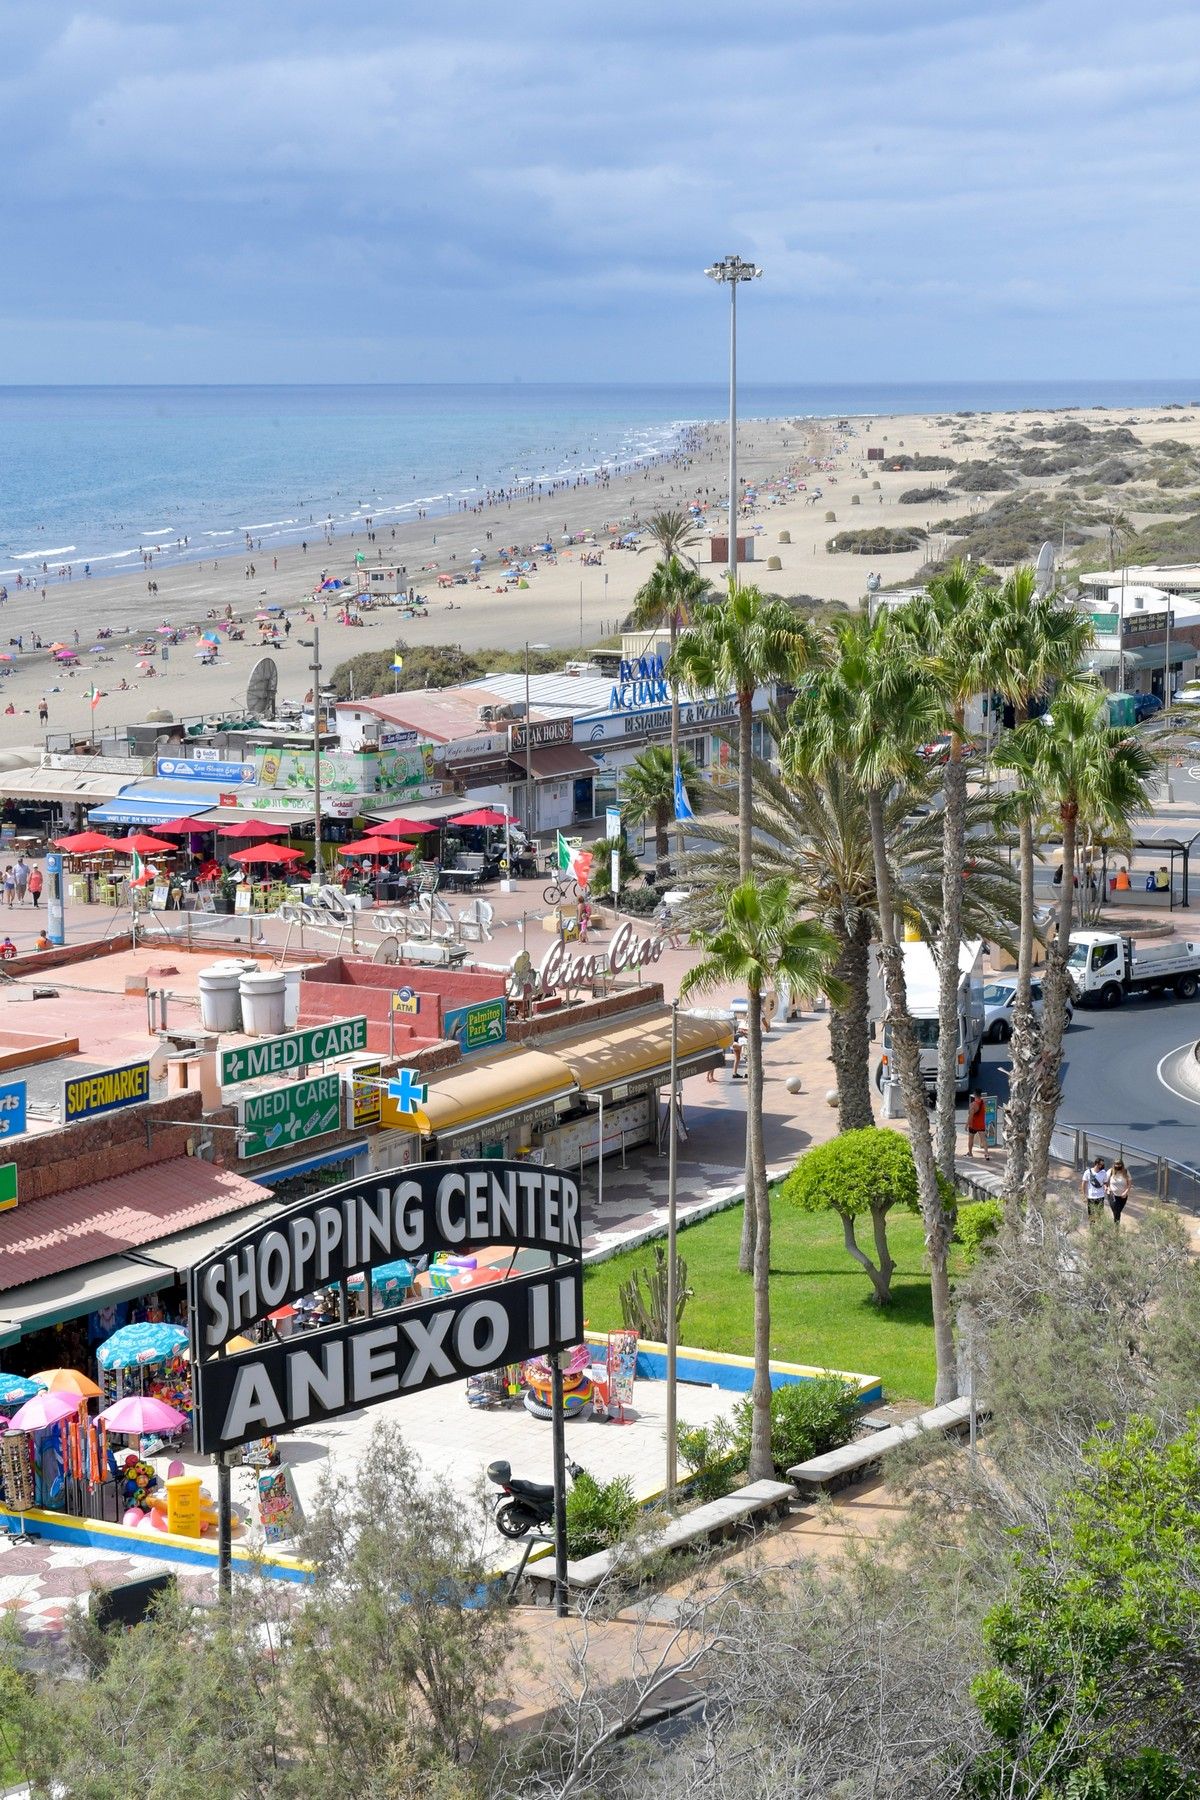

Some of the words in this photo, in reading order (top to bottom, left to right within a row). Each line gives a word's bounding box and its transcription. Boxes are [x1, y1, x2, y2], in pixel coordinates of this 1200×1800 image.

[620, 655, 665, 683] ROMA
[686, 708, 694, 724] &
[516, 727, 542, 745] STAK
[543, 723, 568, 740] HOUSE
[332, 800, 353, 808] Cocktail
[337, 809, 349, 817] Bar
[540, 938, 599, 994] Ciao
[608, 921, 664, 975] Ciao
[396, 1003, 413, 1012] ATM
[469, 1010, 500, 1026] Palmitos
[470, 1023, 487, 1037] Park
[247, 1037, 303, 1076] MEDI
[311, 1021, 364, 1059] CARE
[67, 1065, 149, 1114] SUPERMARKET
[246, 1090, 291, 1123] MEDI
[295, 1077, 338, 1108] CARE
[628, 1083, 648, 1095] Crepes
[453, 1134, 475, 1147] Crepes
[481, 1127, 496, 1138] King
[495, 1118, 516, 1133] Waffel
[523, 1114, 534, 1123] Ice
[534, 1106, 554, 1119] Cream
[204, 1181, 424, 1346] SHOPPING
[436, 1171, 580, 1248] CENTER
[220, 1300, 510, 1440] ANEXO
[529, 1276, 576, 1350] II
